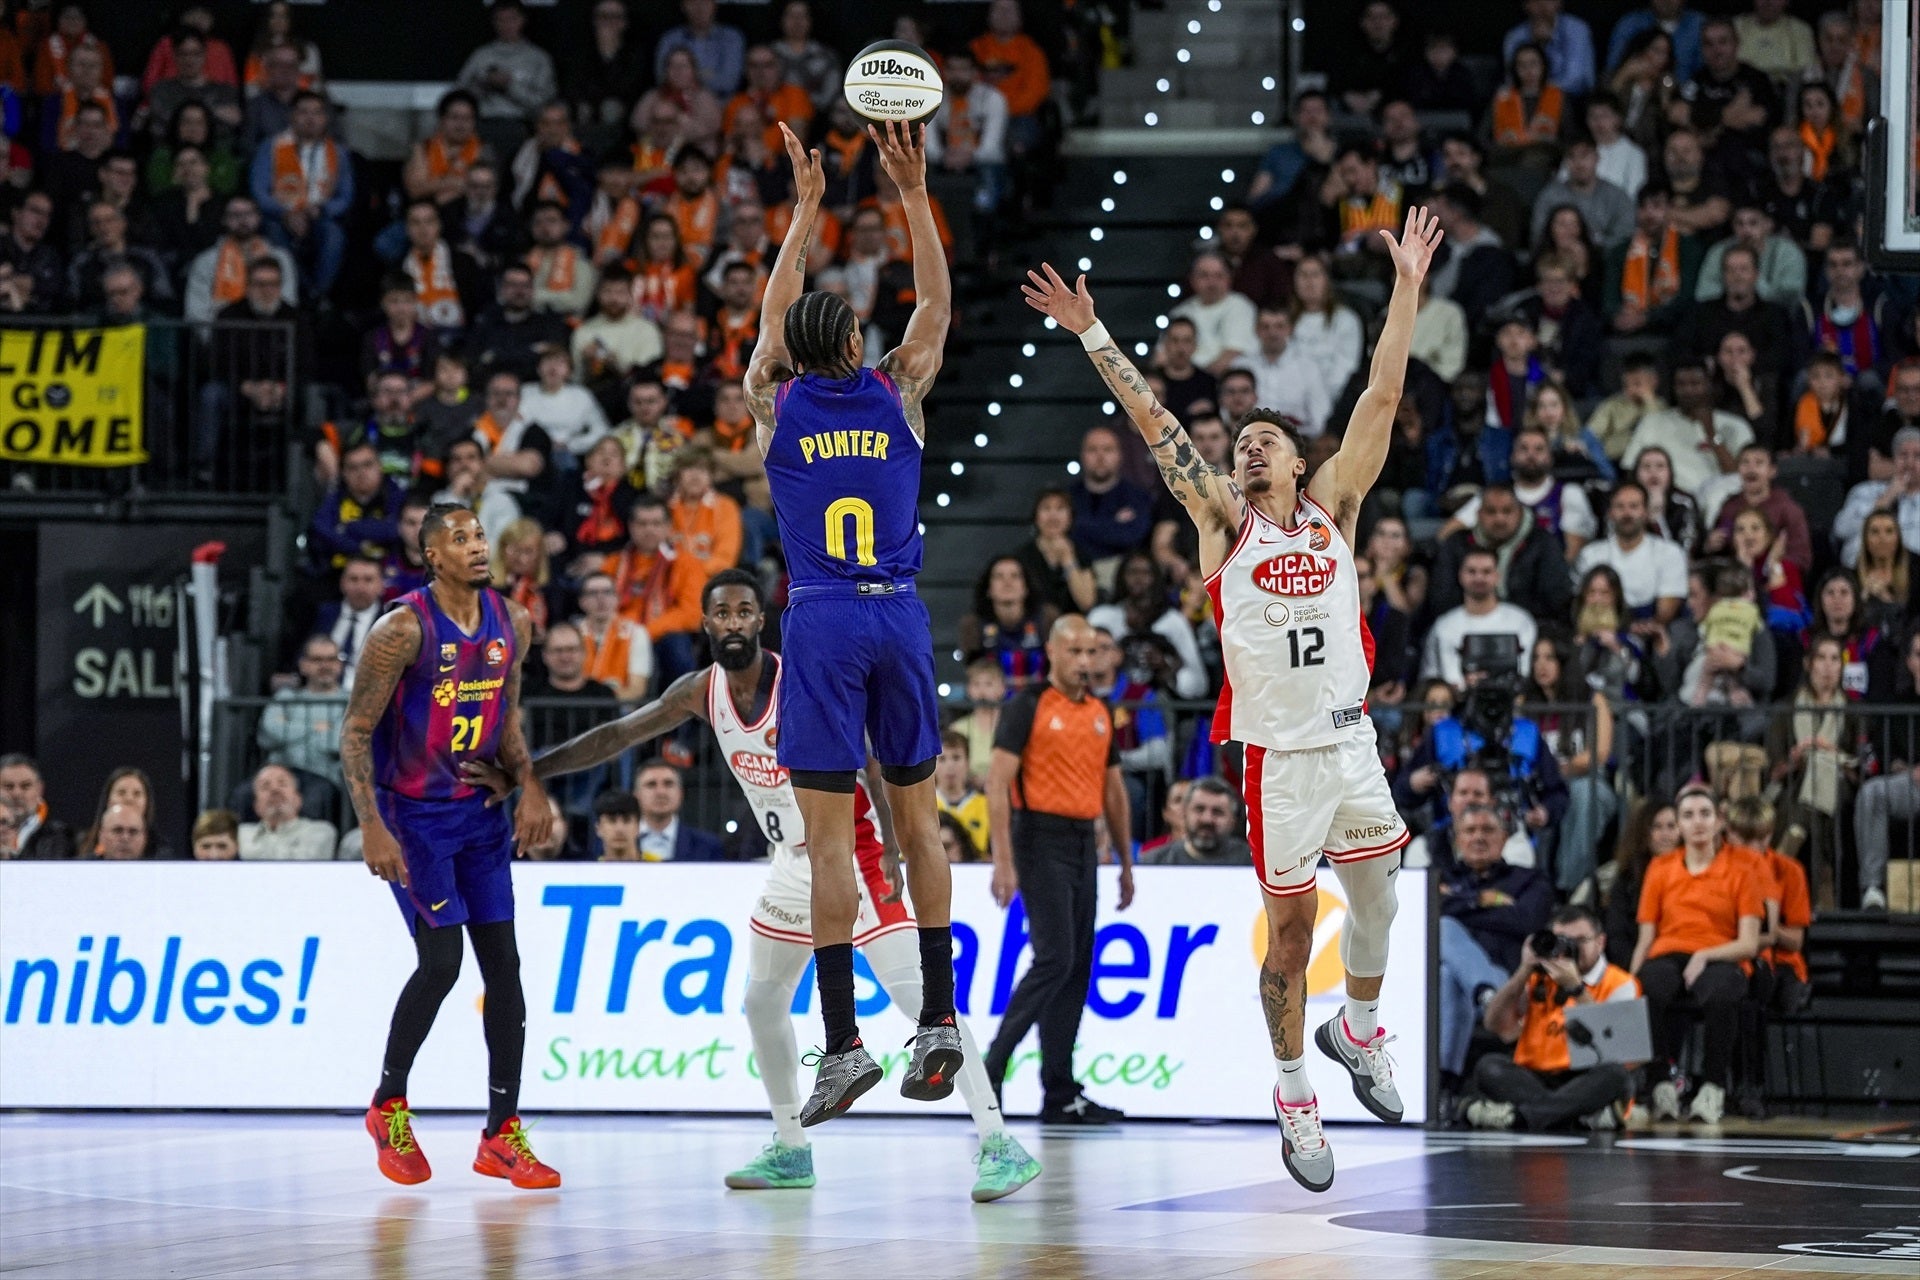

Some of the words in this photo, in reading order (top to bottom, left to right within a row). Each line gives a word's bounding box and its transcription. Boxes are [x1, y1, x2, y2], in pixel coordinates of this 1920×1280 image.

[861, 59, 925, 81] Wilson
[858, 93, 888, 107] Copa
[905, 98, 925, 108] Rey
[864, 90, 880, 98] acb
[864, 105, 890, 115] Valencia
[799, 430, 890, 465] PUNTER
[825, 497, 878, 567] 0
[1269, 553, 1330, 575] UCAM
[1260, 575, 1335, 595] MURCIA
[1286, 626, 1326, 669] 12
[451, 715, 484, 753] 21
[737, 753, 777, 770] UCAM
[735, 766, 788, 786] MURCIA
[766, 811, 784, 842] 8
[542, 1036, 734, 1082] Smart
